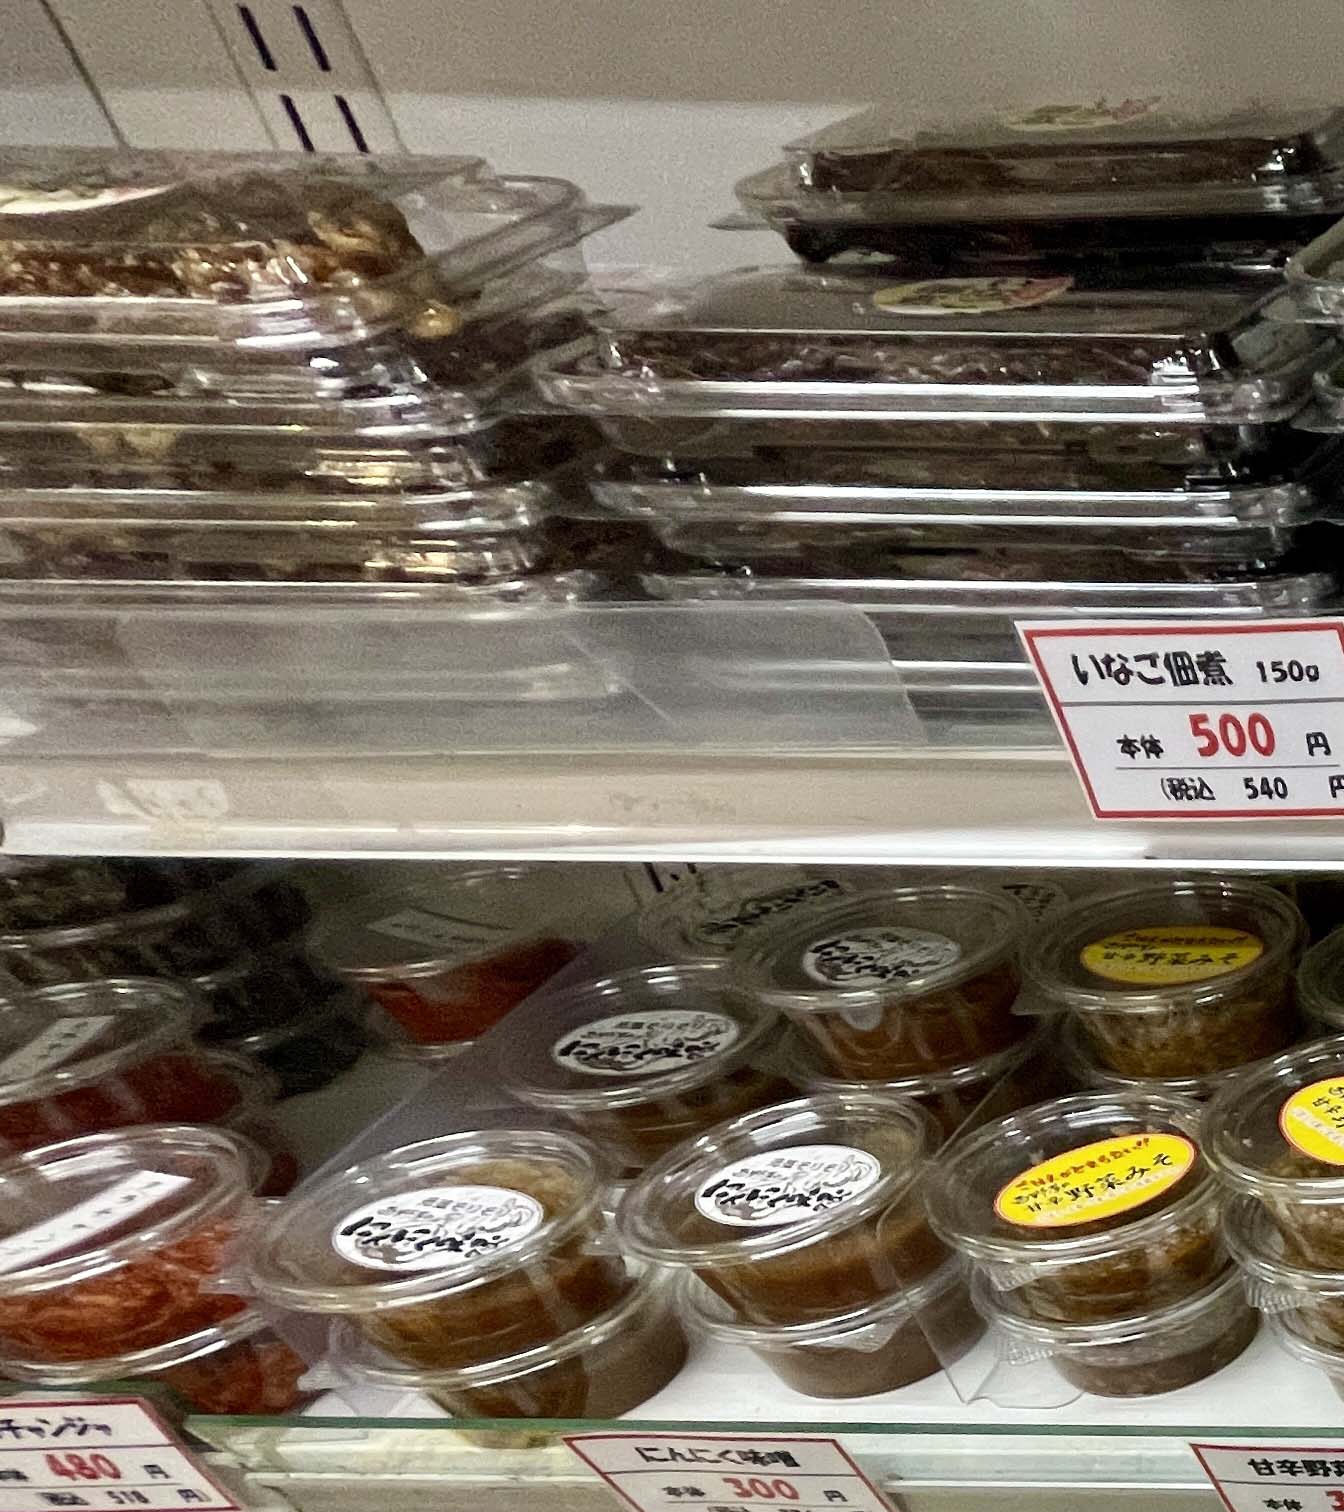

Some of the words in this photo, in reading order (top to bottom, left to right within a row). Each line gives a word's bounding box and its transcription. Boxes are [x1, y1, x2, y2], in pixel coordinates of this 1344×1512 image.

[1070, 650, 1234, 687] いなご佃煮
[1255, 659, 1321, 684] 150g
[1116, 734, 1165, 759] 本体
[1188, 712, 1276, 757] 500
[1306, 731, 1332, 756] 円
[1160, 776, 1216, 802] (税込
[1243, 776, 1288, 800] 540
[45, 1453, 123, 1481] 480
[143, 1463, 172, 1480] 円
[721, 1477, 800, 1501] 300
[823, 1489, 850, 1503] 円
[1261, 1498, 1304, 1512] 本体
